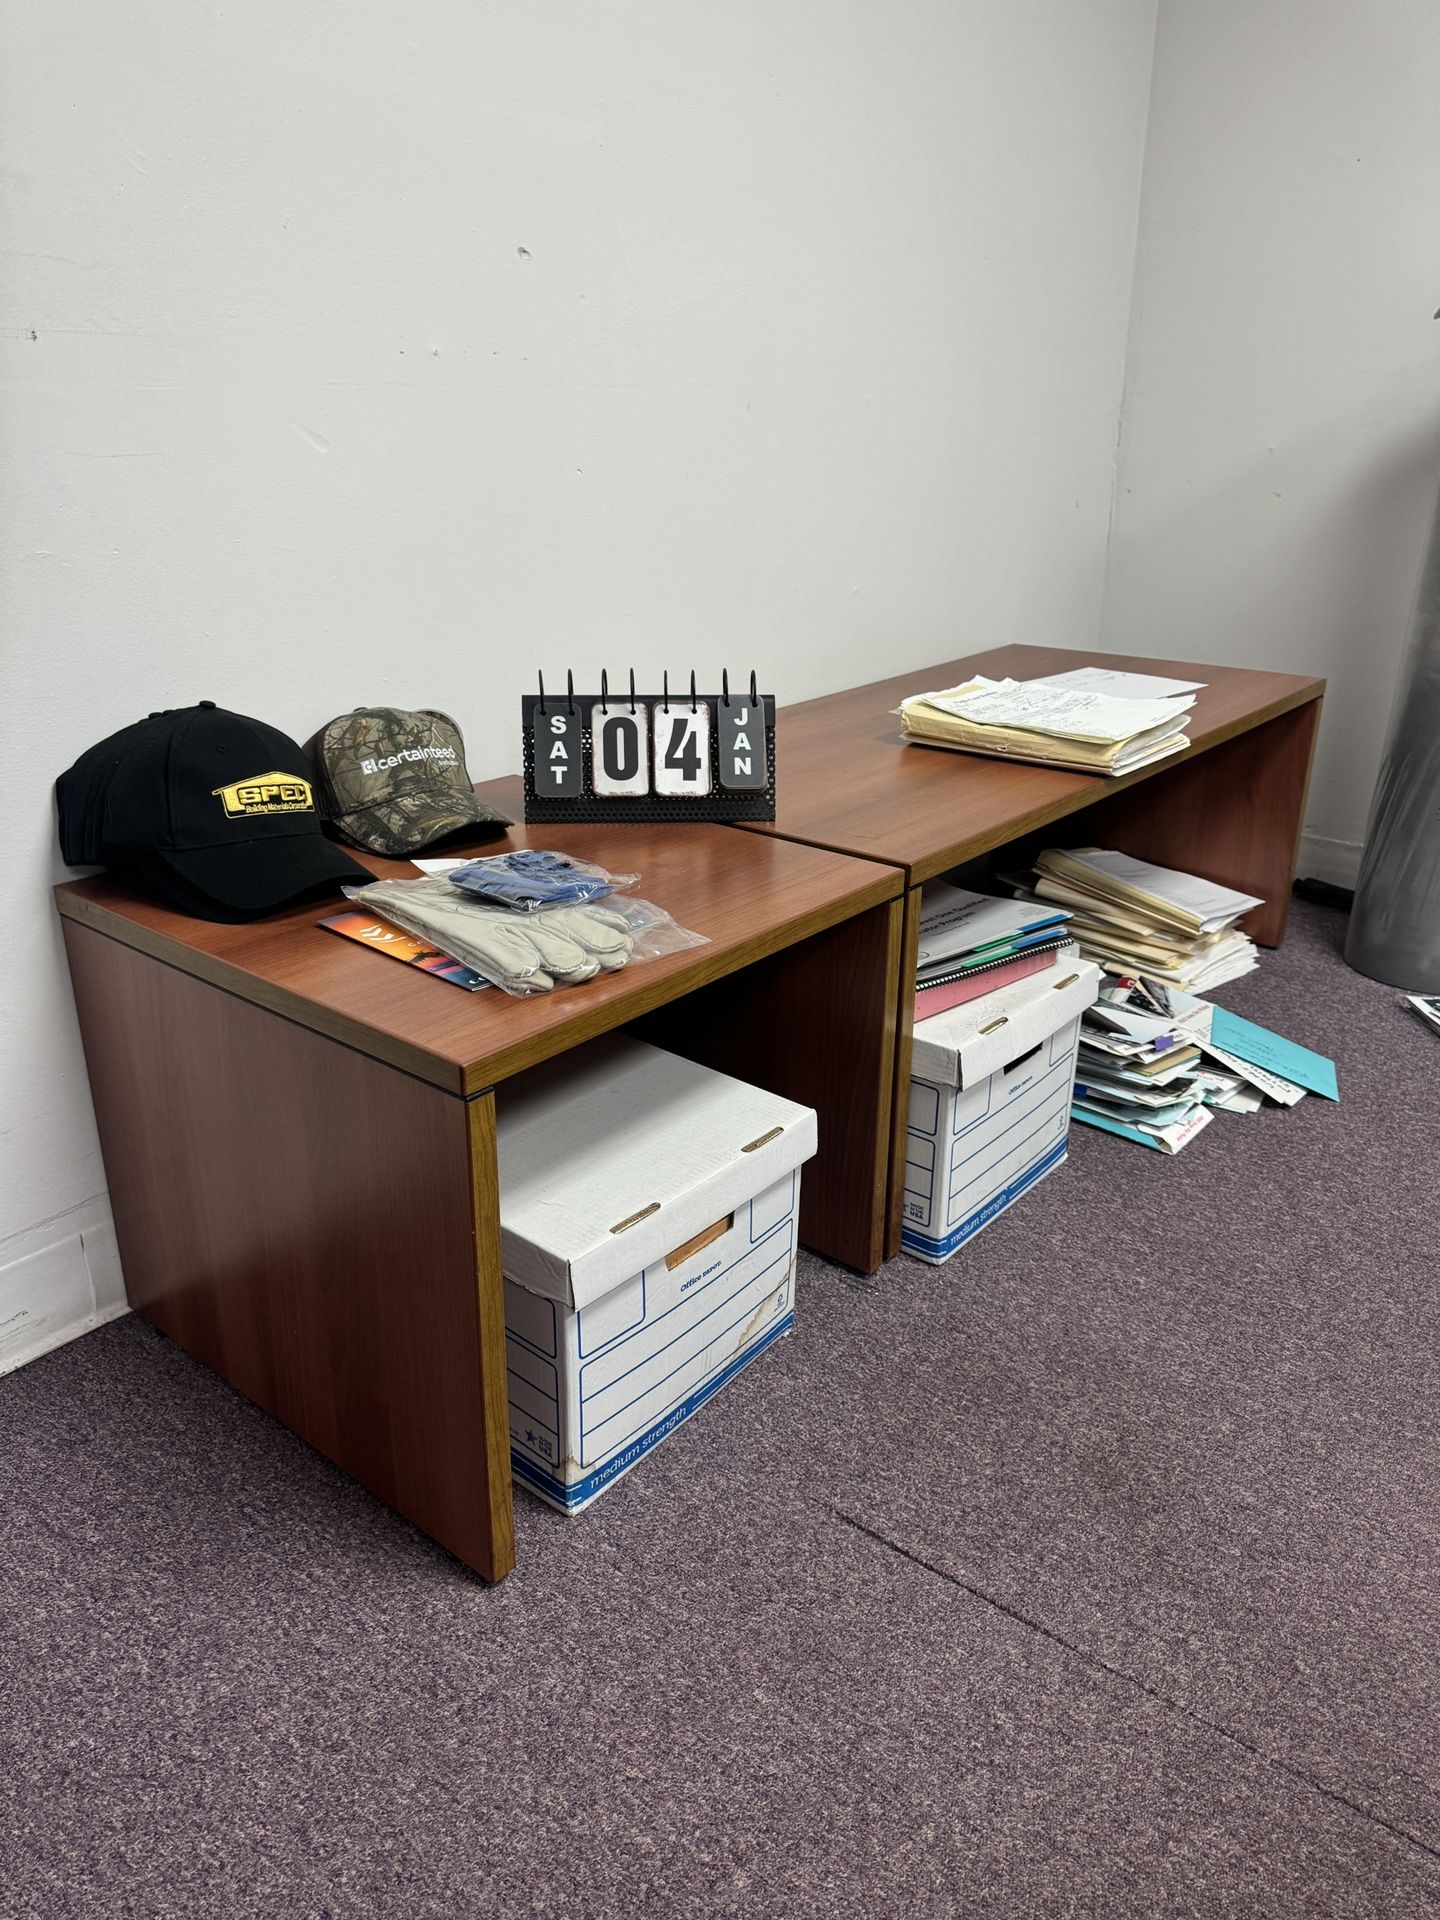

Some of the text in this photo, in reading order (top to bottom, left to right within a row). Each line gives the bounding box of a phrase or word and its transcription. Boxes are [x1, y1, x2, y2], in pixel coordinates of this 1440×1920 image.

[377, 745, 456, 770] certainteed
[550, 715, 568, 784] SAT
[733, 707, 752, 776] JAN
[238, 784, 307, 805] SPEC
[910, 1211, 924, 1220] USA
[950, 1194, 1007, 1246] medium strength
[680, 1274, 702, 1292] Office
[589, 1405, 687, 1489] medium strength
